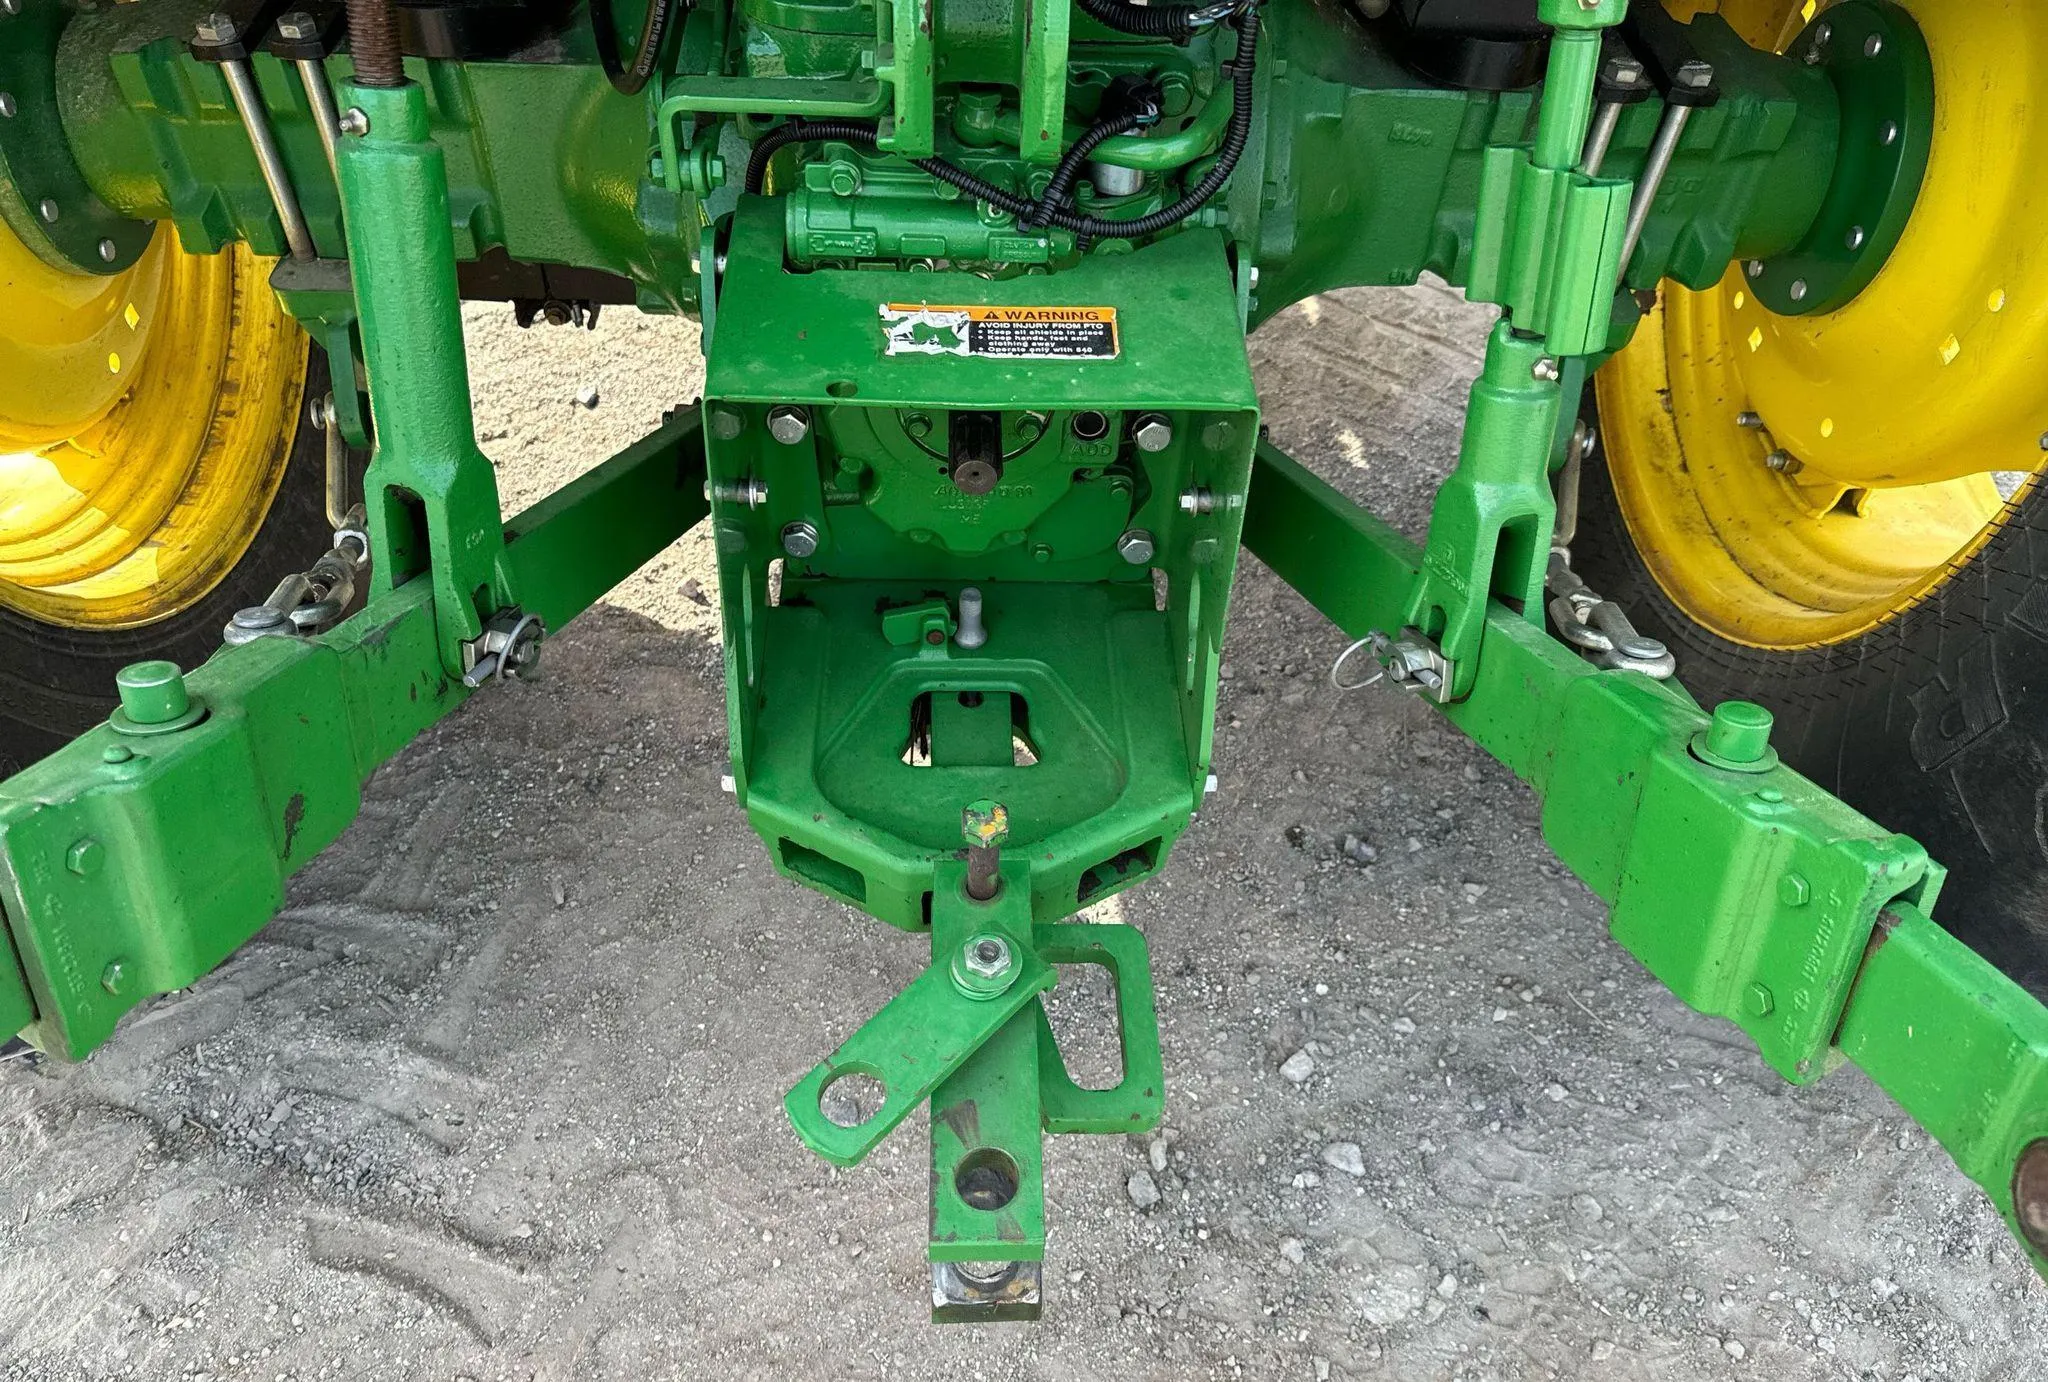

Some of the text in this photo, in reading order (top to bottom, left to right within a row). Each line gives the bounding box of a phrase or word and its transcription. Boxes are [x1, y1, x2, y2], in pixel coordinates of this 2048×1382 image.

[1004, 311, 1099, 321] WARNING
[1012, 322, 1049, 330] INJURY
[1071, 443, 1113, 457] ADD
